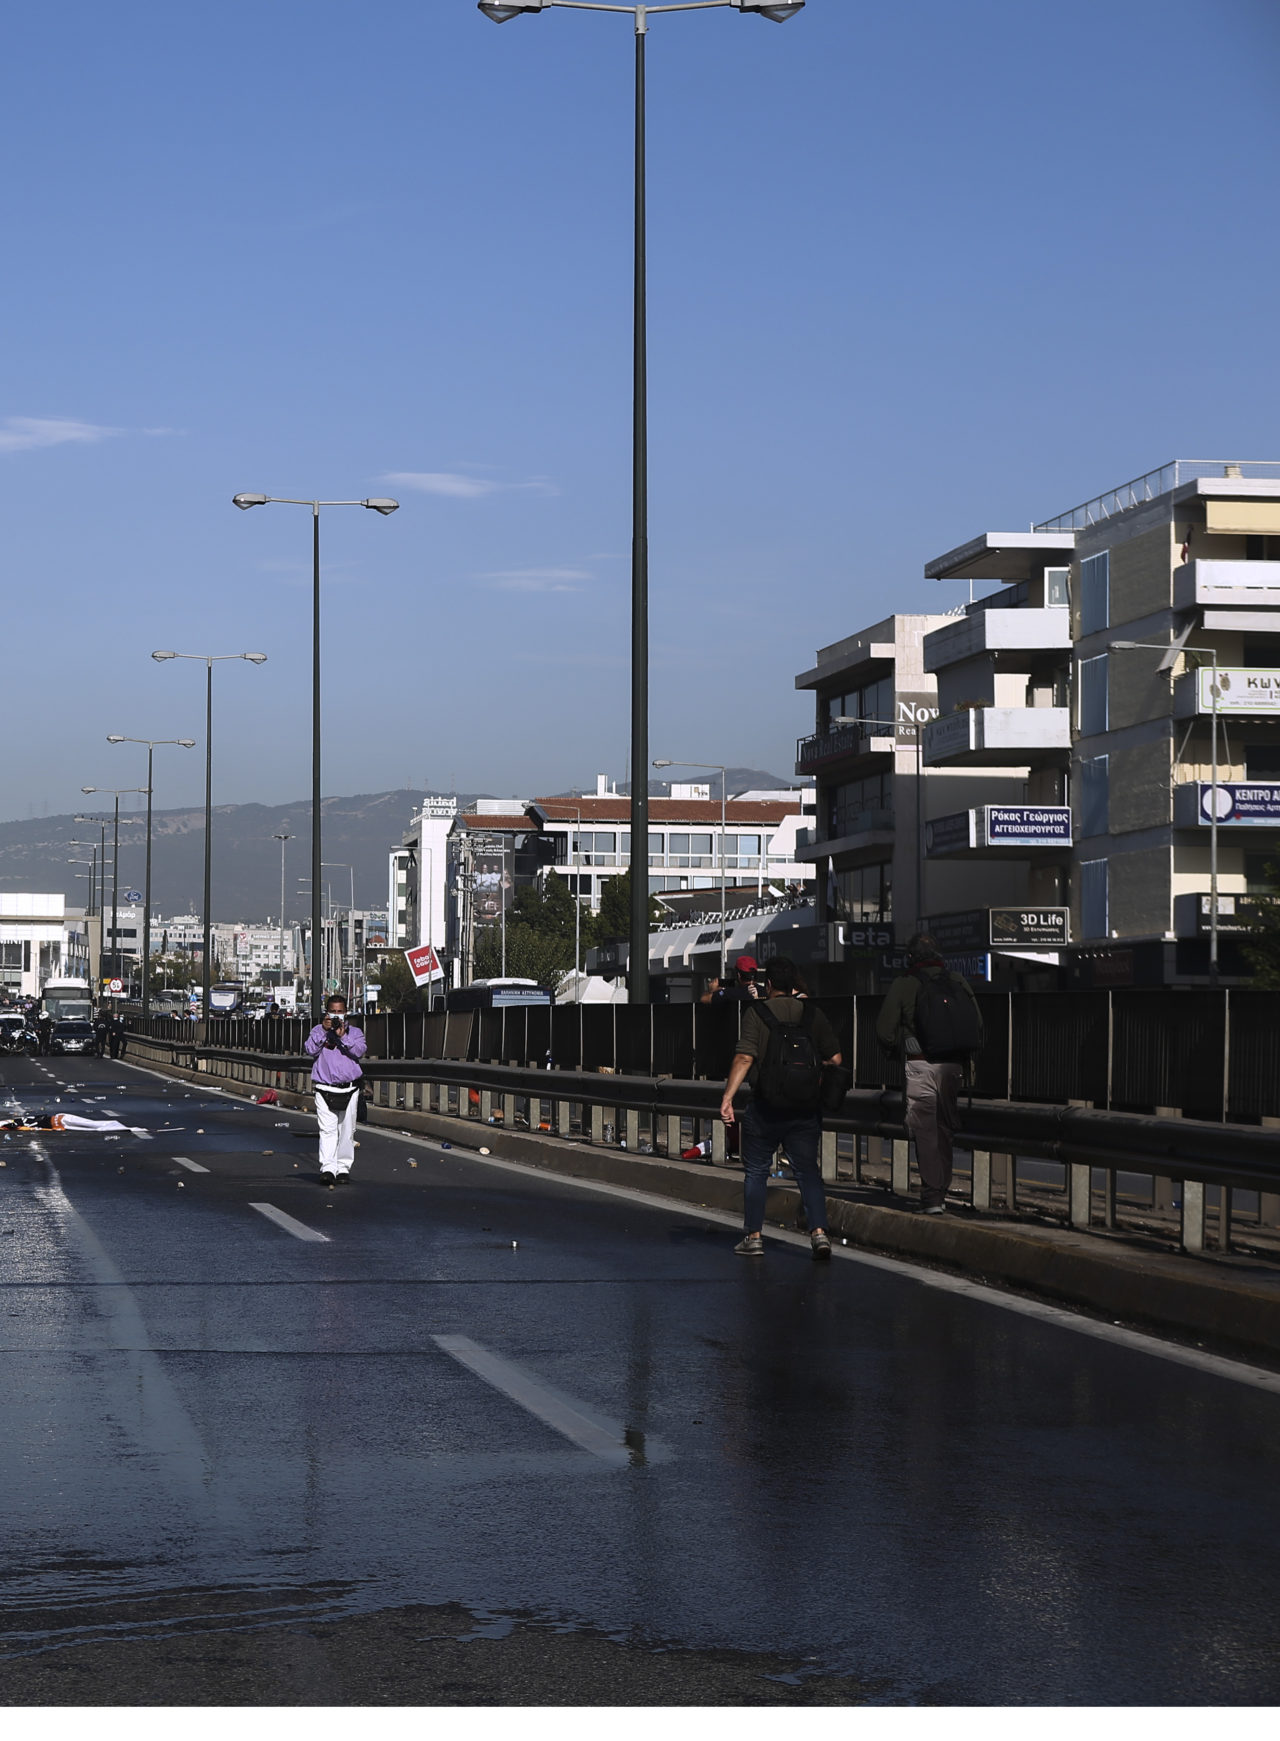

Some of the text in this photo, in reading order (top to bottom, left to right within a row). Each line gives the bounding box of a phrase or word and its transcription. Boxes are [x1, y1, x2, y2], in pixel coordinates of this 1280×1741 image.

[1235, 789, 1271, 801] ΚΕΝΤΡΟ
[991, 810, 1069, 824] Ρόκας Γεώργιος
[994, 824, 1066, 834] ΑΓΓΕΙΟΧΕΙΡΟΥΡΓΟΣ
[1020, 914, 1064, 925] 3D Life
[838, 925, 890, 946] Leta
[883, 954, 910, 969] Let
